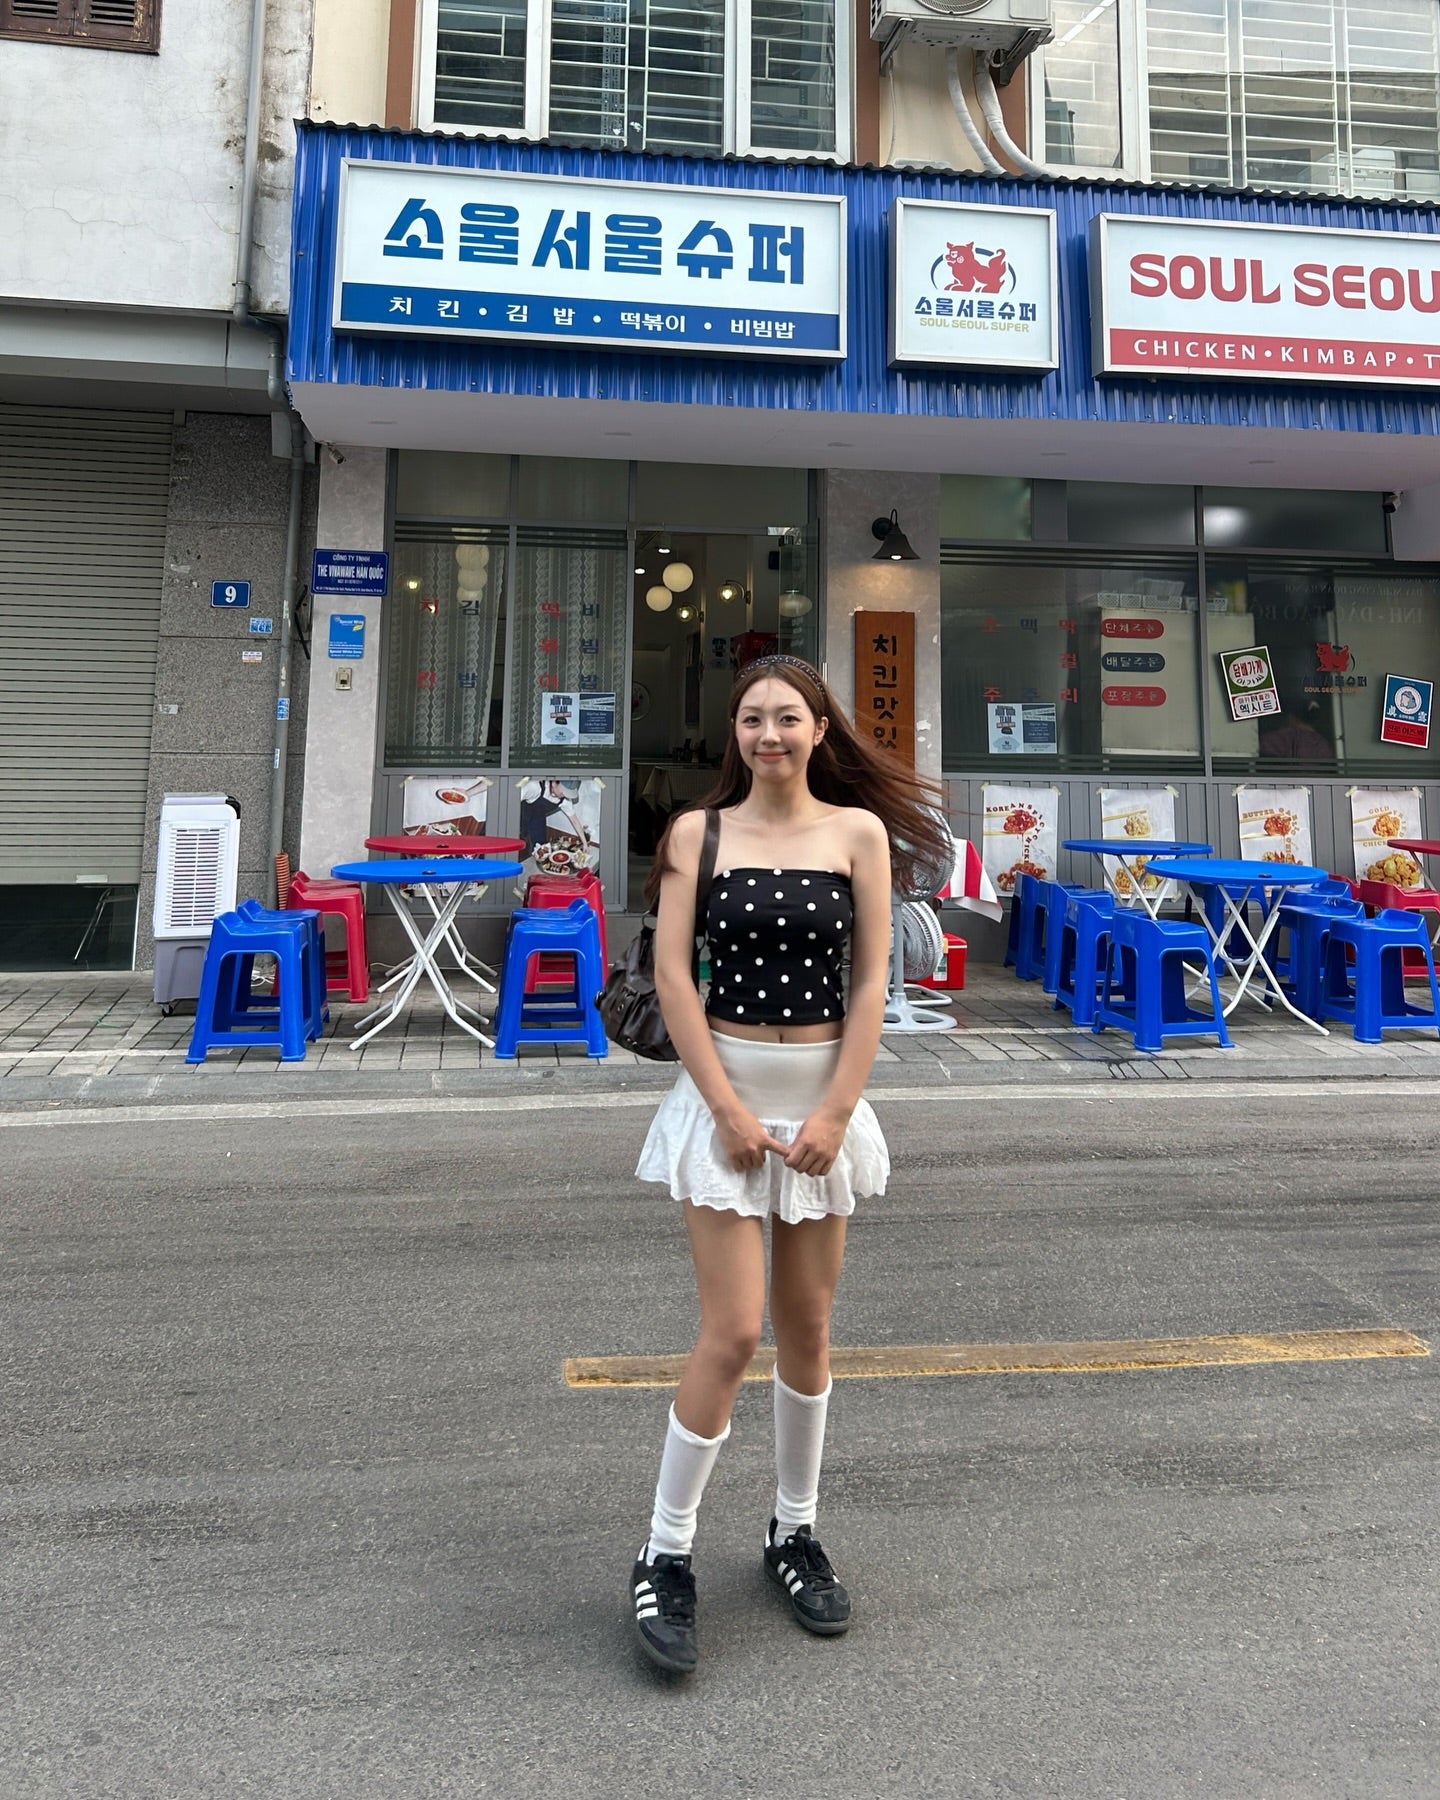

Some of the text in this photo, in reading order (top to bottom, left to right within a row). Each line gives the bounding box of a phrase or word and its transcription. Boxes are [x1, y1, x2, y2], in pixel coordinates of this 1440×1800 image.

[383, 198, 805, 285] 소울서울슈퍼
[1129, 253, 1440, 314] SOUL SEOU
[914, 295, 1037, 322] 소울서울슈퍼
[620, 311, 687, 334] 떡볶이
[730, 318, 796, 340] 비빔밥
[919, 316, 1030, 333] SOUL SEOUL SUPER
[1134, 338, 1256, 361] CHICKEN
[1281, 346, 1398, 369] KIMBAP
[317, 564, 328, 577] THE
[225, 585, 237, 604] 9
[986, 802, 1025, 813] KOREAN
[1242, 808, 1275, 819] BUTTER
[1369, 805, 1390, 815] GOLD
